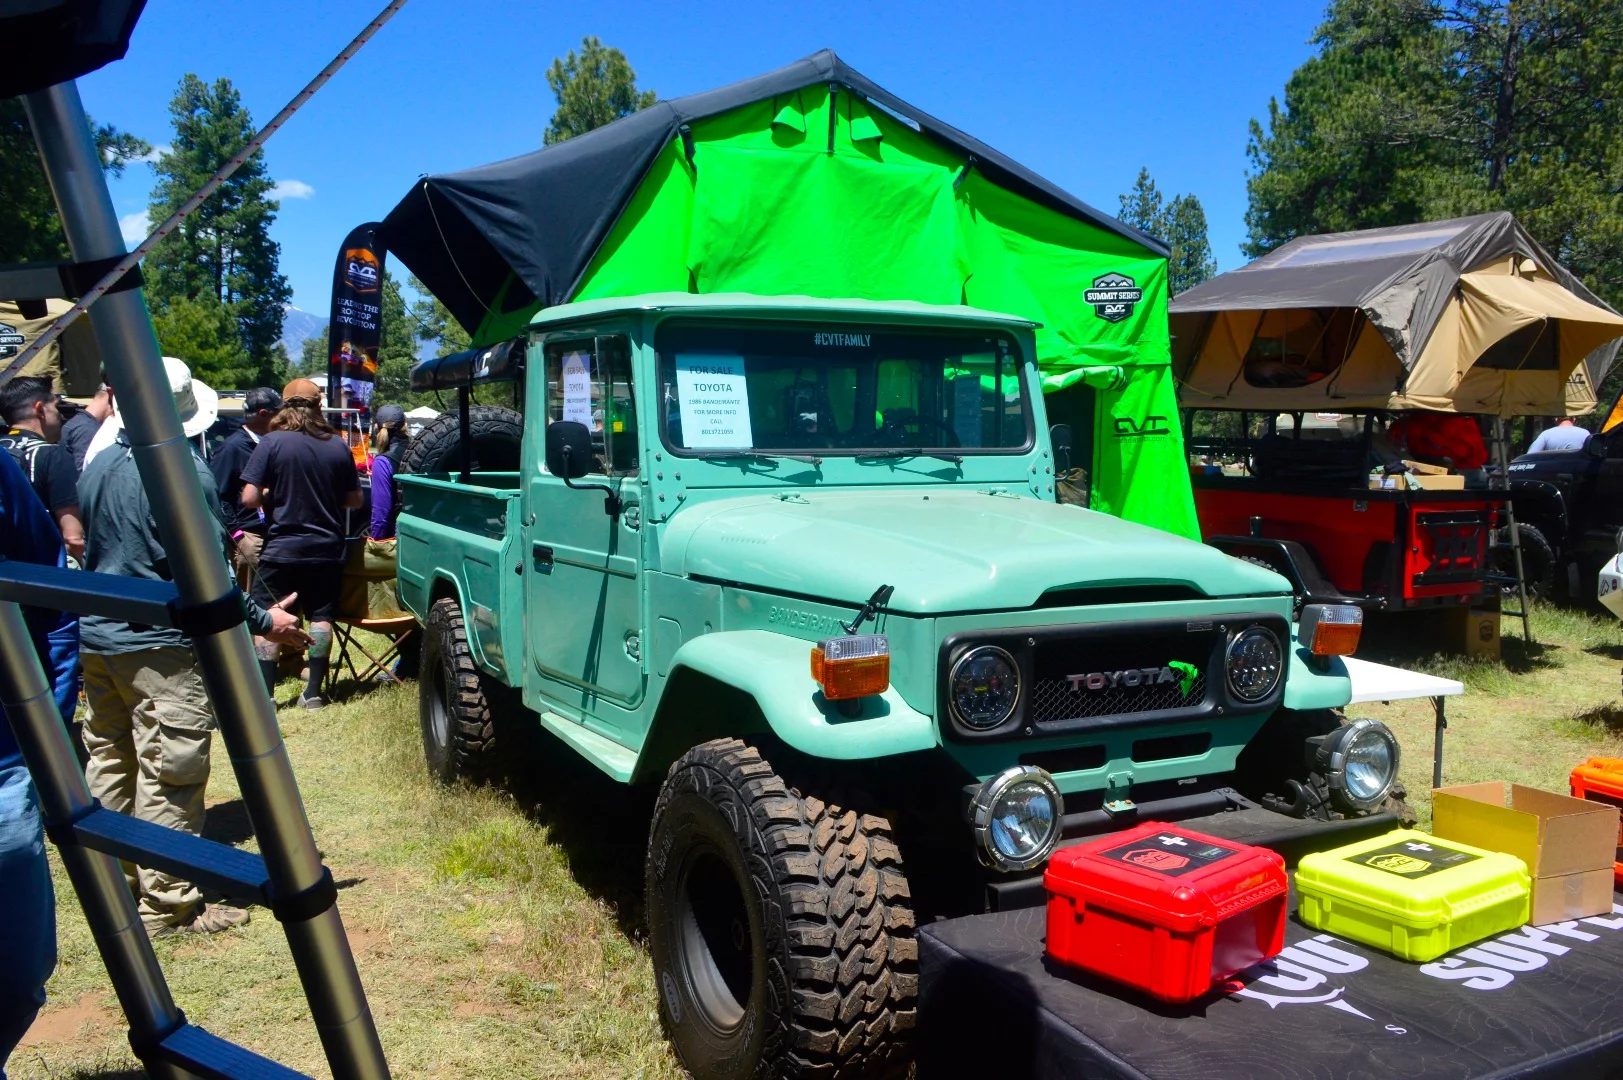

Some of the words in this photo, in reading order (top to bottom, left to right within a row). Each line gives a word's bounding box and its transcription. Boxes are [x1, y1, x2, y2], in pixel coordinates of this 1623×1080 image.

[1087, 292, 1118, 300] SUMMIT
[1118, 291, 1140, 299] SERIES
[363, 304, 379, 314] THE
[1105, 305, 1125, 313] CVT
[814, 332, 871, 347] #CVTFAMILY
[690, 366, 708, 374] FOR
[711, 366, 733, 374] SALE
[693, 383, 732, 392] TOYOTA
[1112, 416, 1171, 437] CVT
[1066, 666, 1175, 692] TOYOTA
